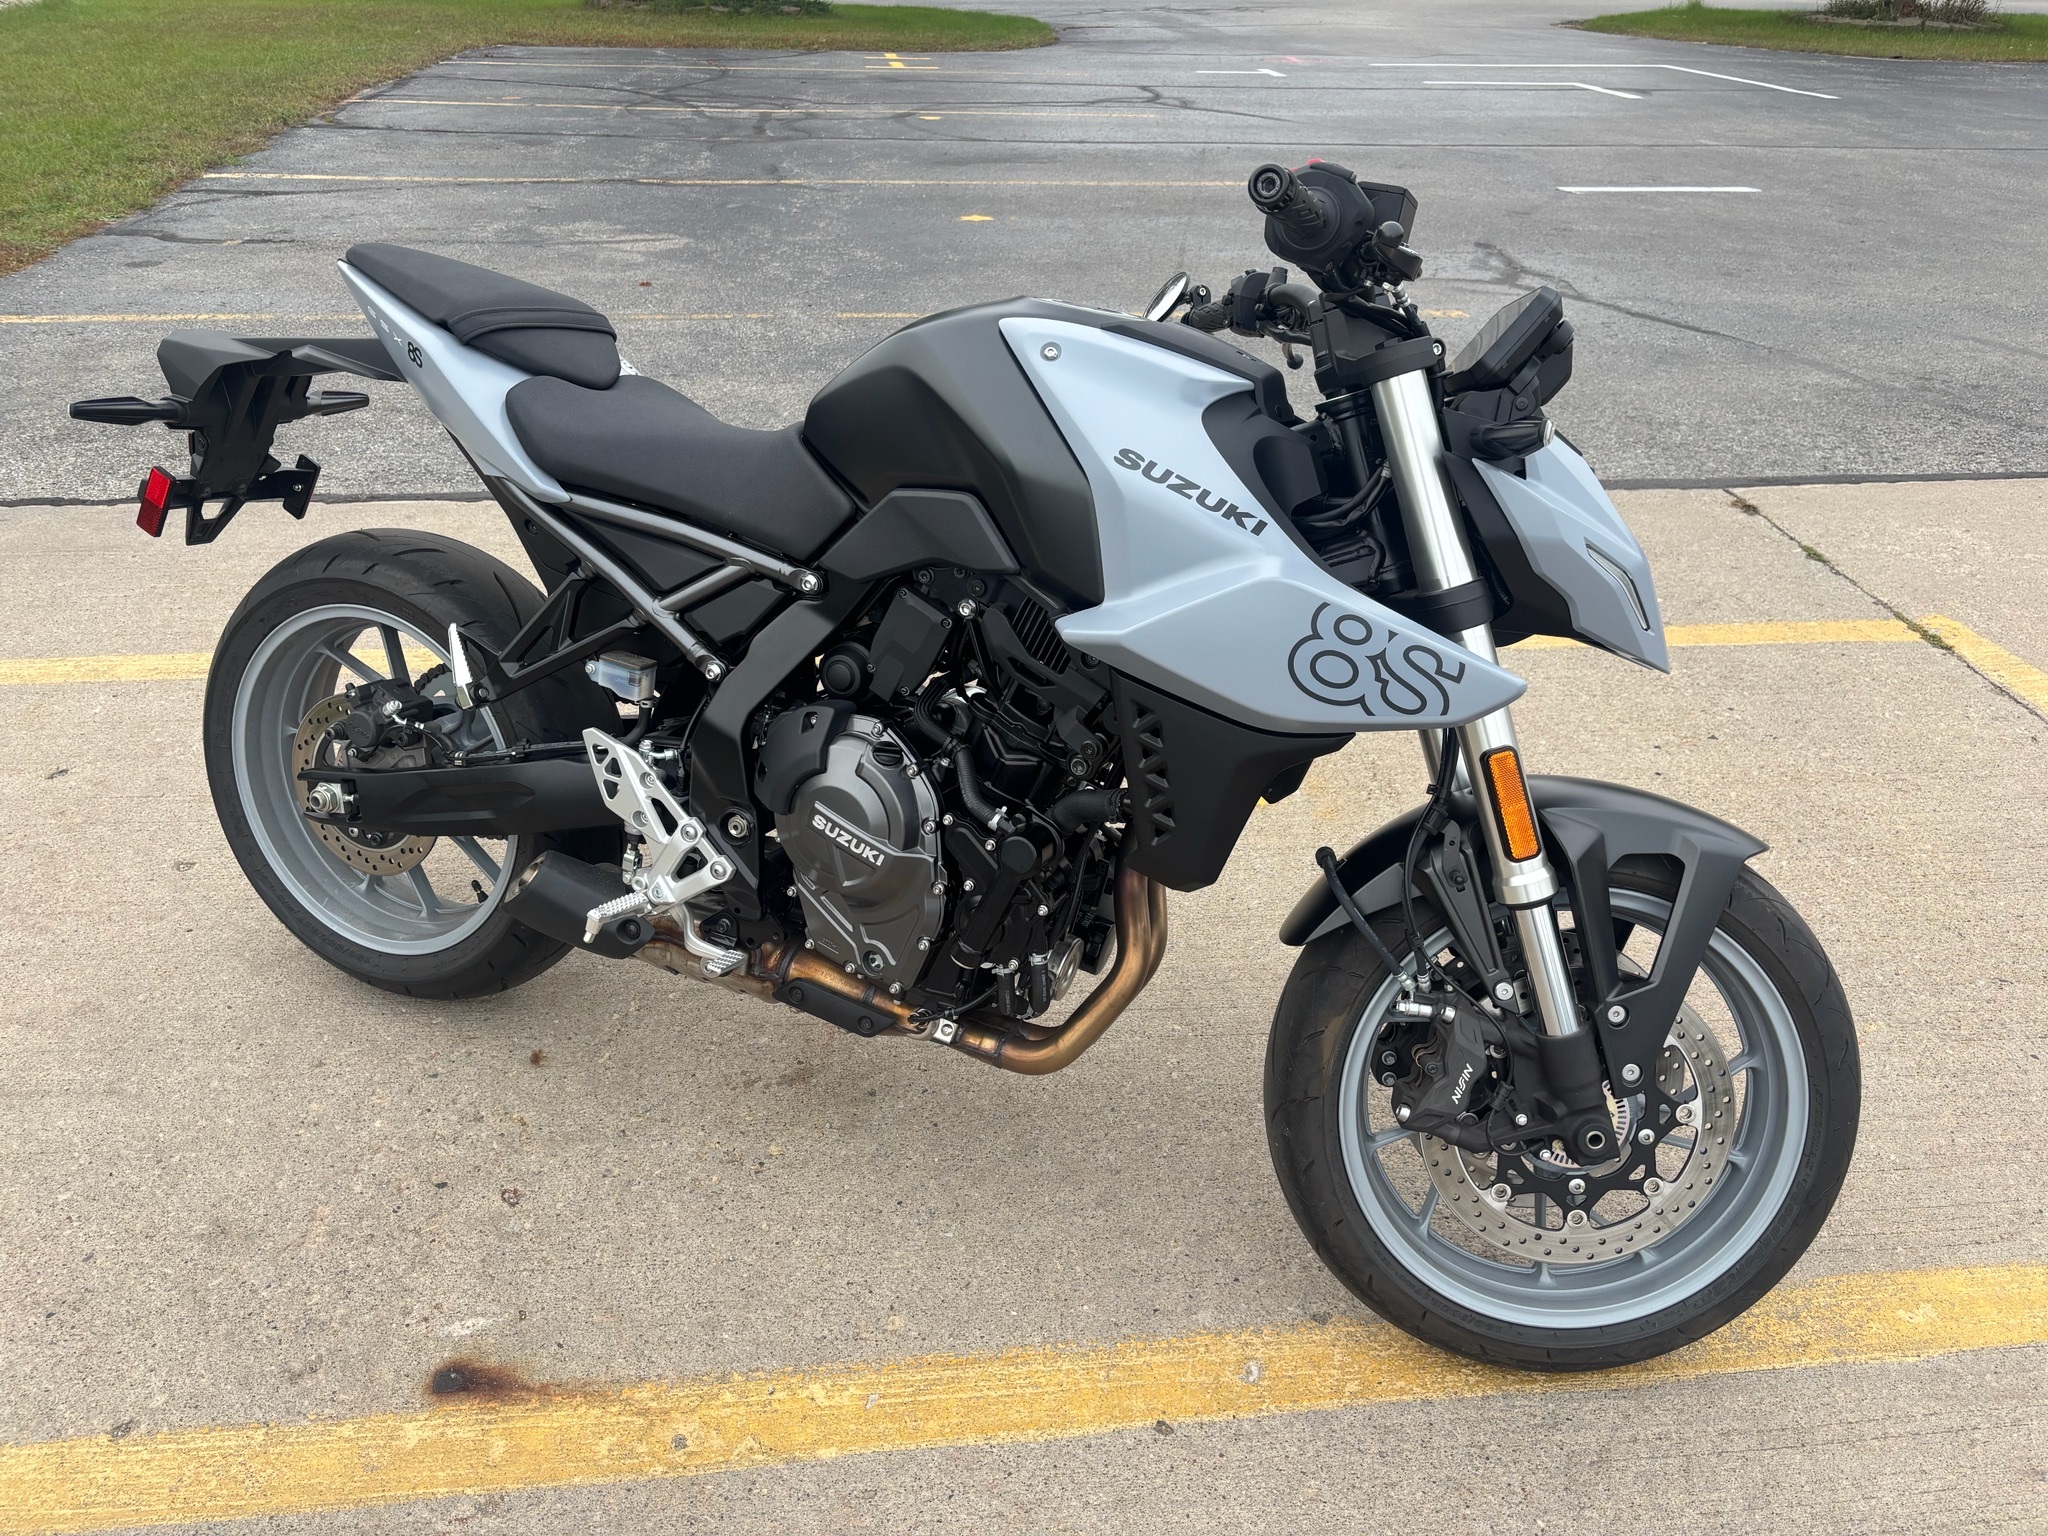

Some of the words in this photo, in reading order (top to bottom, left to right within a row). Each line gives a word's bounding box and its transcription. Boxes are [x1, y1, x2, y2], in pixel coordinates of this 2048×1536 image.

[1113, 447, 1269, 537] SUZUKI
[811, 813, 885, 867] SUZUKI
[1451, 1062, 1474, 1105] NISSIN
